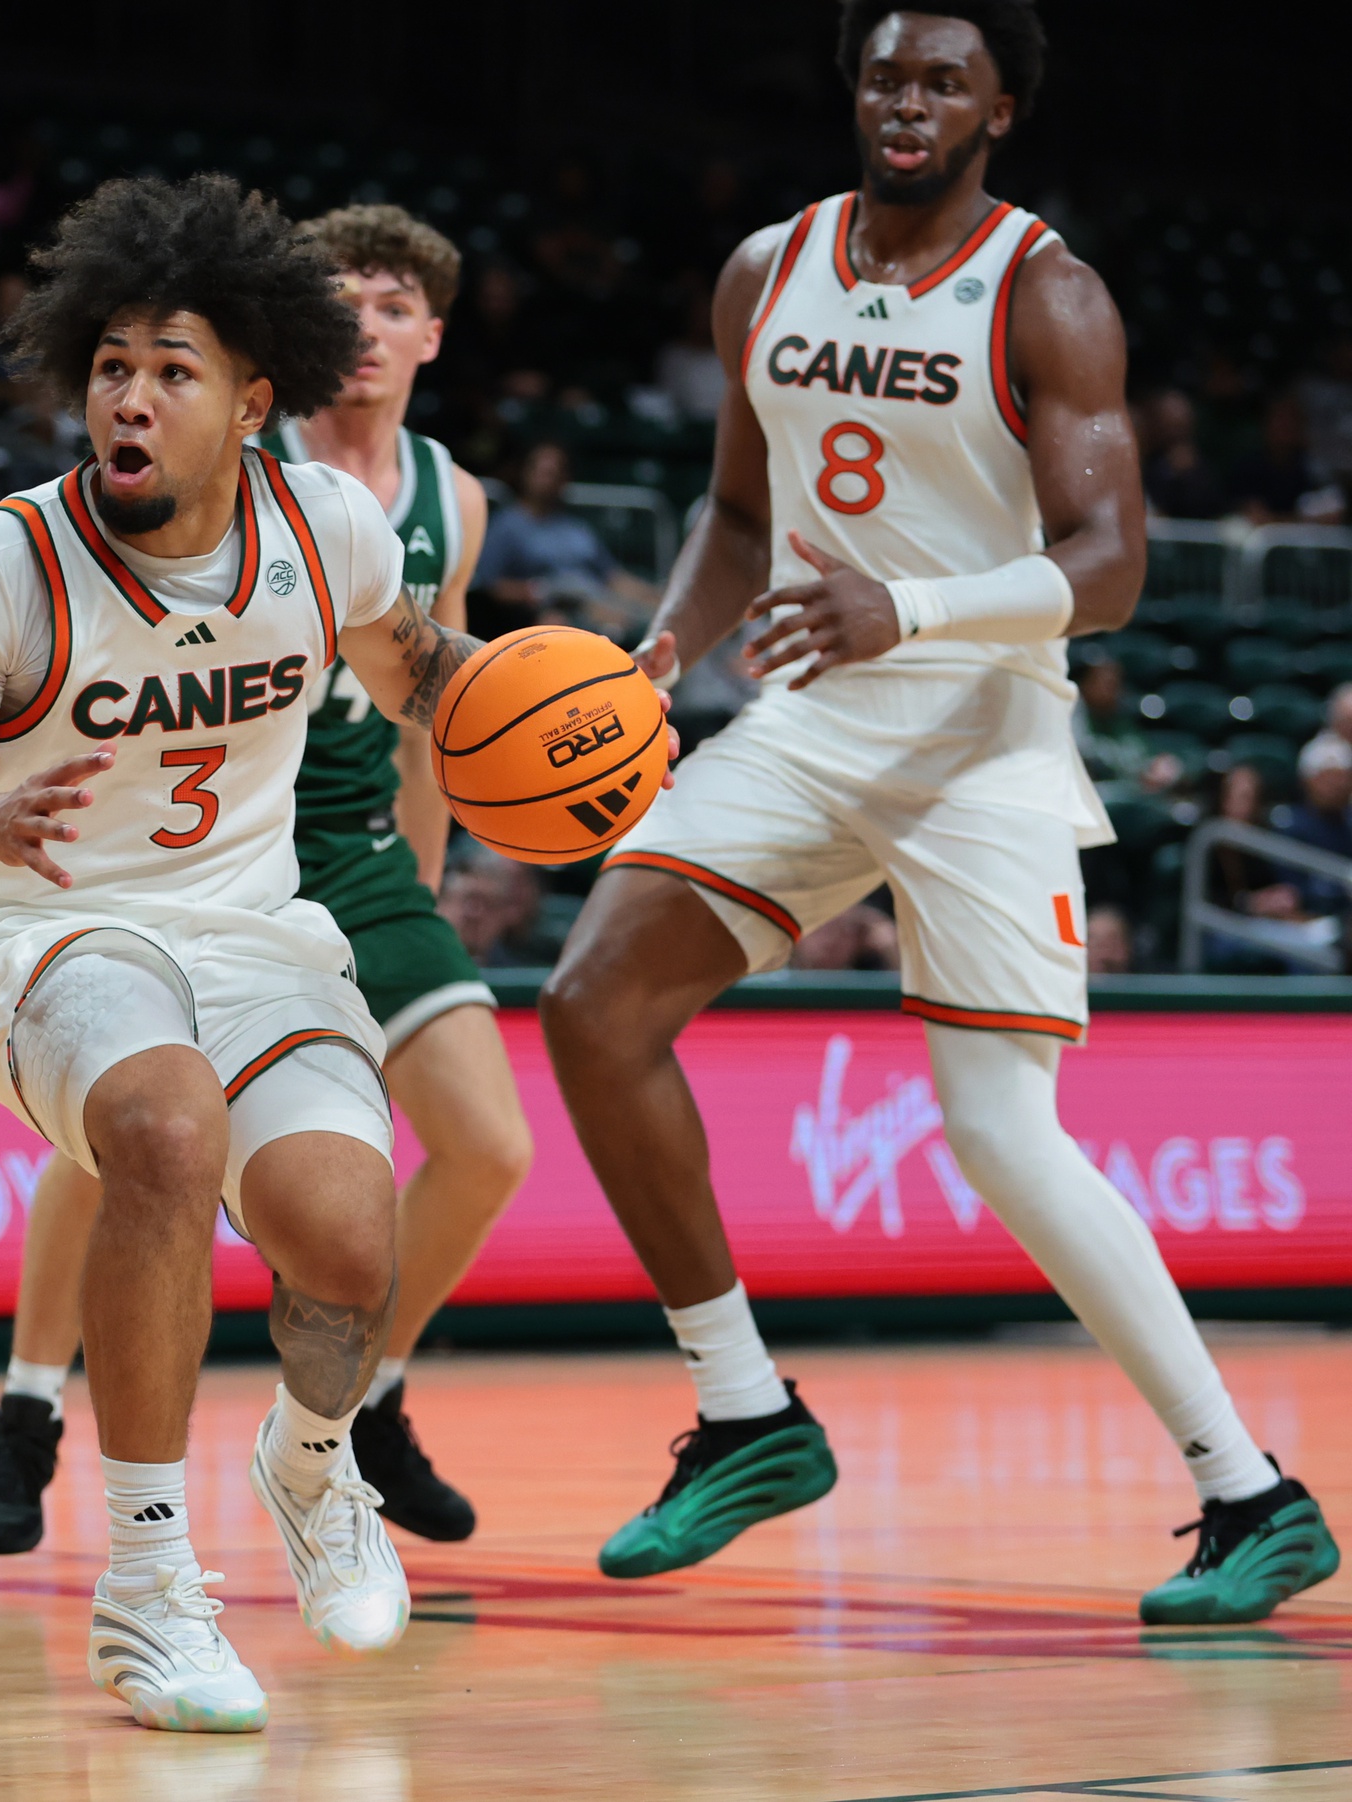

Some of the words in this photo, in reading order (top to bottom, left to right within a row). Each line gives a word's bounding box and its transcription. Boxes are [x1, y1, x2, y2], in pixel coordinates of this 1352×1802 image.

[768, 335, 963, 405] CANES
[816, 420, 886, 515] 8
[271, 569, 294, 582] ACC
[71, 654, 308, 740] CANES
[560, 717, 582, 733] GAME
[582, 701, 613, 721] OFFICIAL
[539, 728, 560, 742] BALL
[547, 714, 625, 768] PRO
[149, 744, 227, 849] 3
[790, 1034, 944, 1238] Virgin
